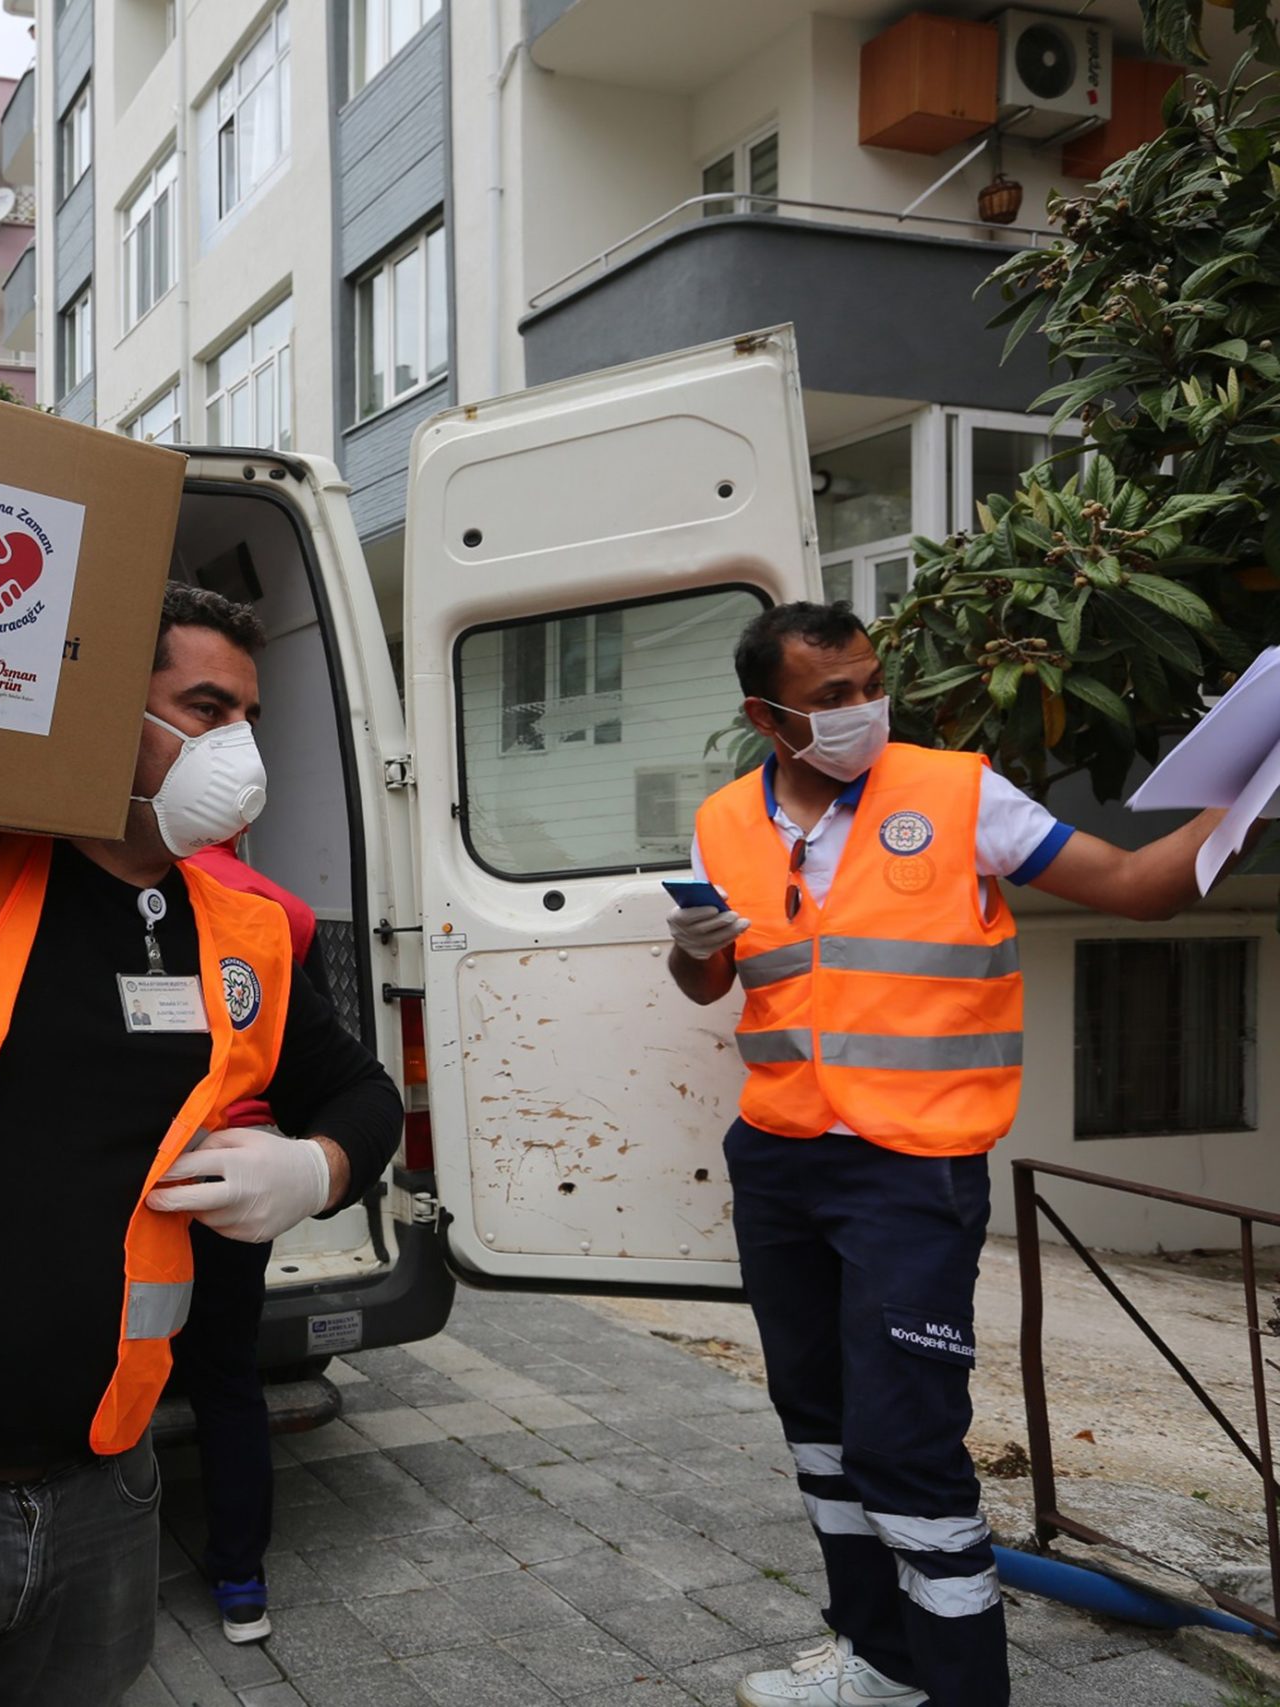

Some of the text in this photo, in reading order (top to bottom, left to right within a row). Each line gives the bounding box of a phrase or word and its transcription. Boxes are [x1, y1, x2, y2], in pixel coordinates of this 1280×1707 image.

[16, 508, 54, 556] Zamanı
[890, 1328, 947, 1352] BÜYÜKŞEHİR
[925, 1322, 962, 1342] MUĞLA
